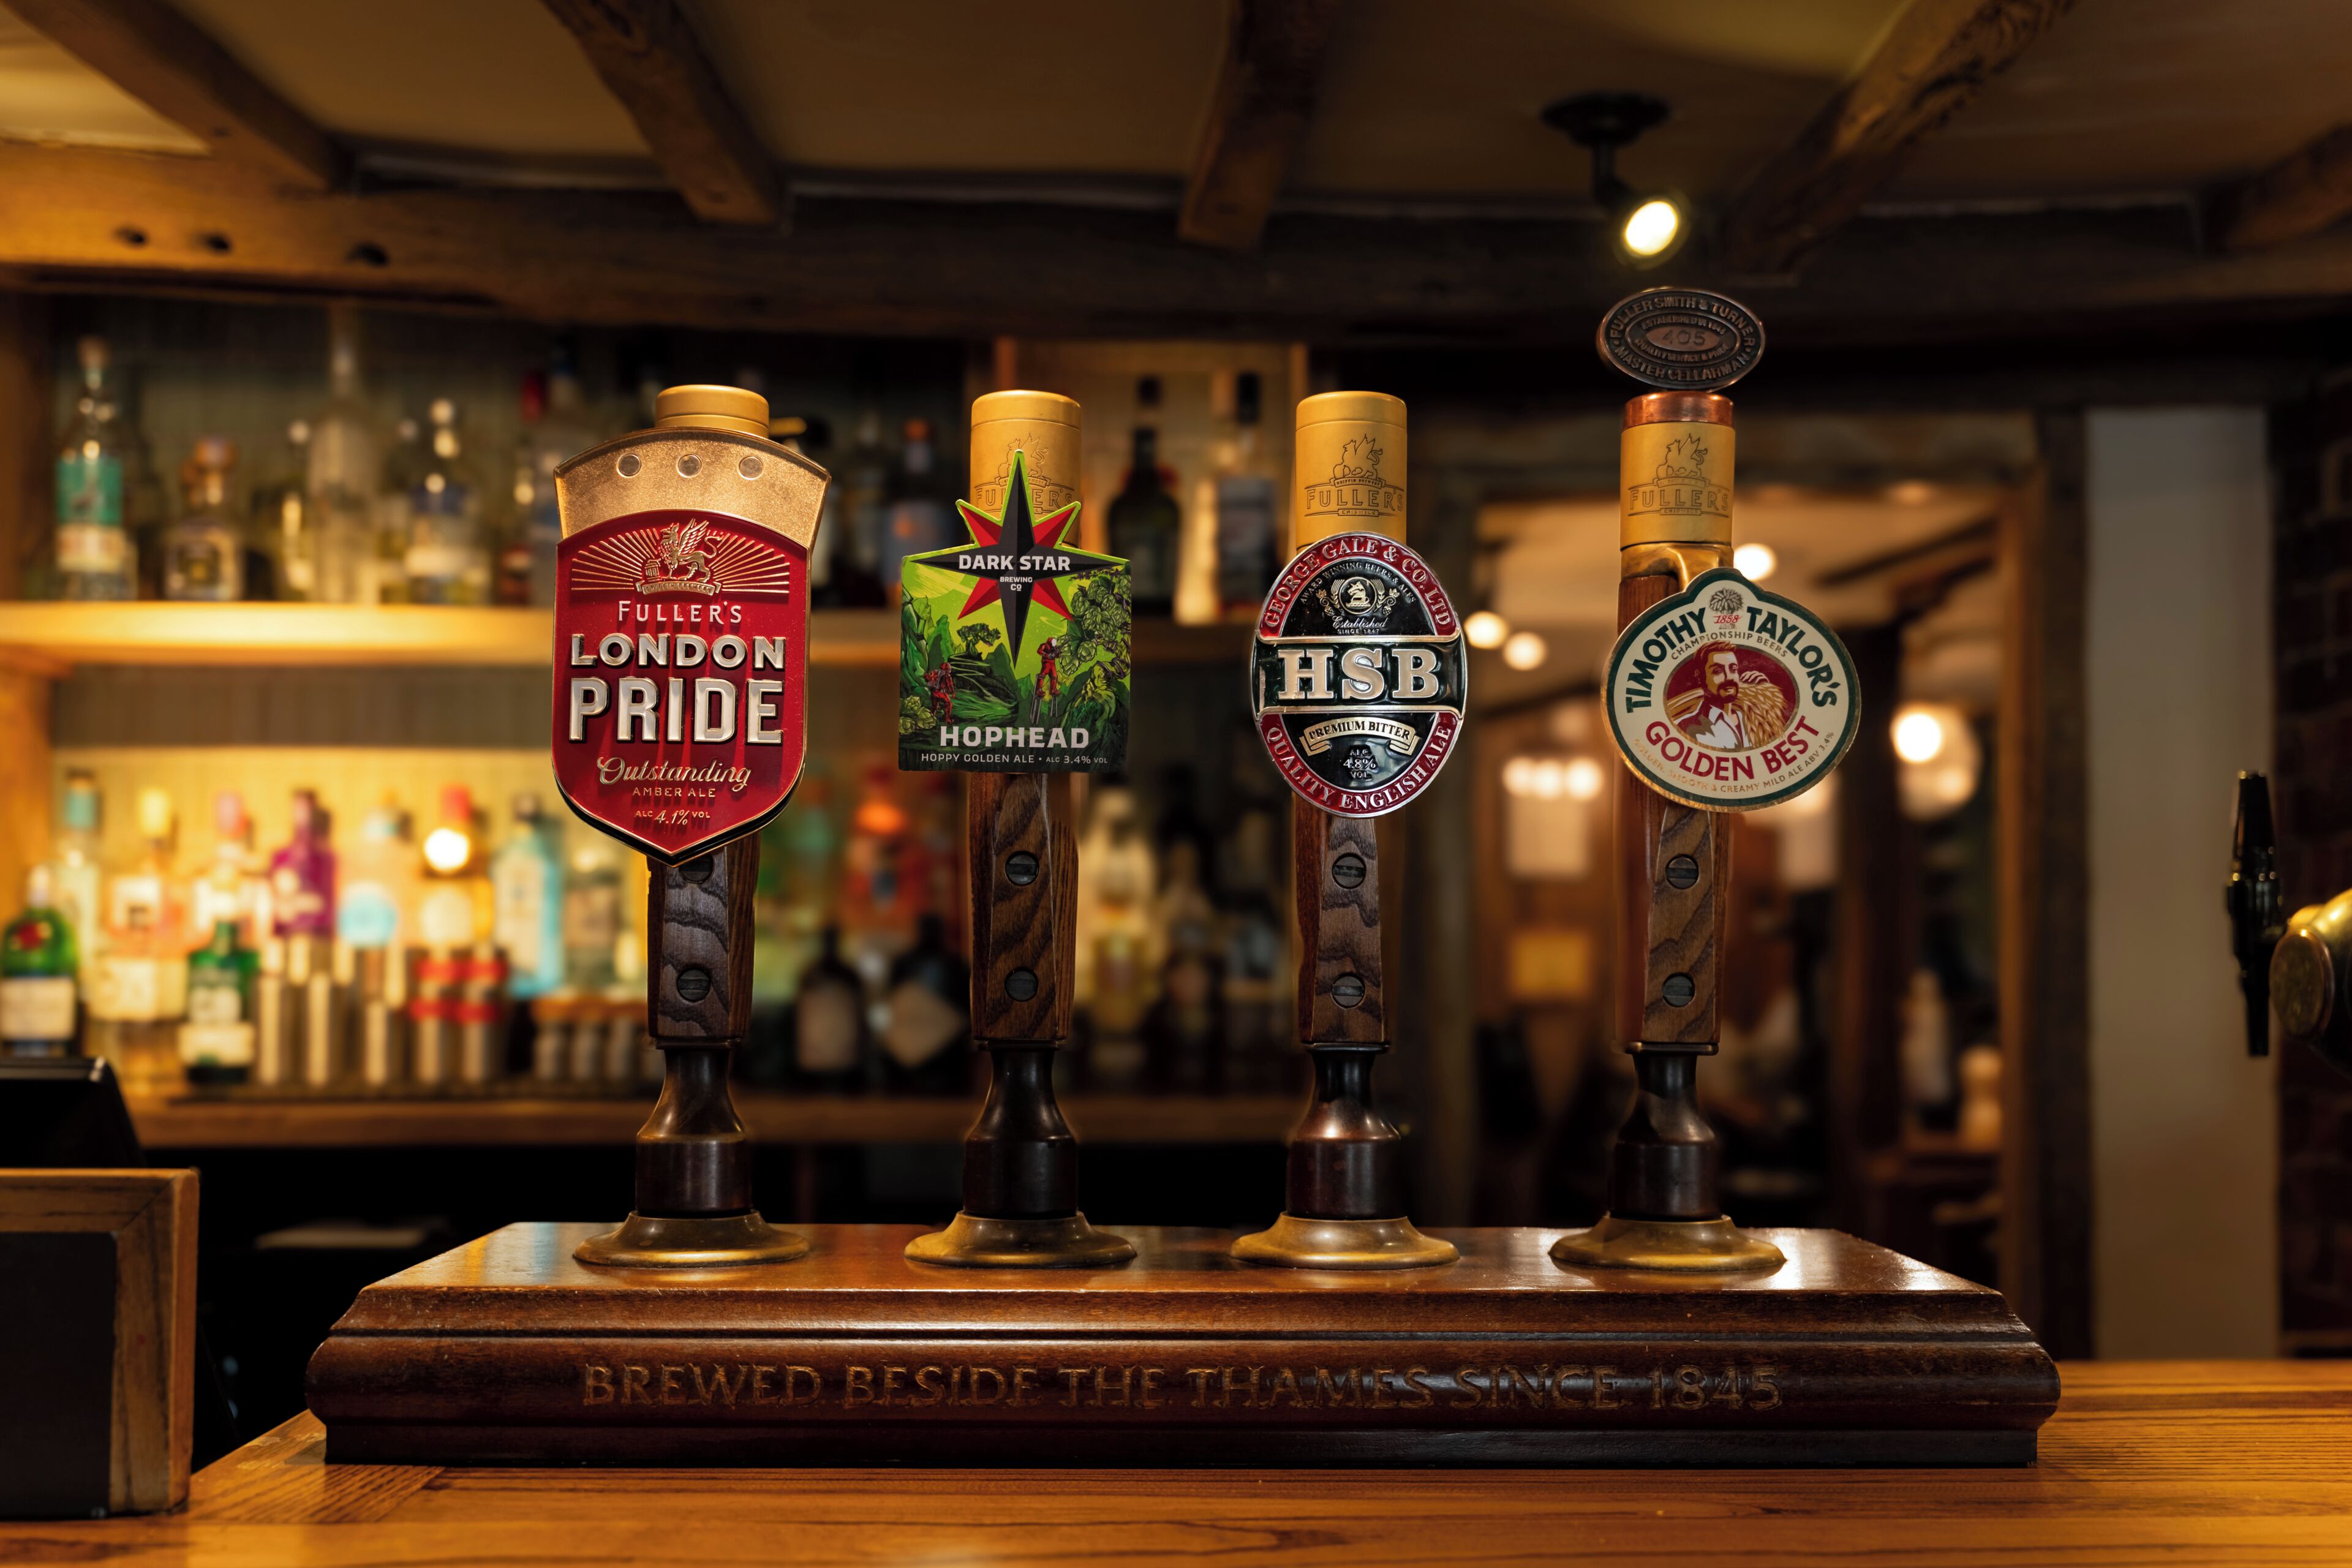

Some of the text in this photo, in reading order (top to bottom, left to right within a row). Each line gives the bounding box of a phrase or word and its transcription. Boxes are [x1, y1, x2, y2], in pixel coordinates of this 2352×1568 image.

[1610, 296, 1755, 348] FULLER SMITH & TURNER
[1615, 345, 1751, 381] MASTER CELLARMAN
[976, 488, 1072, 509] FUER'S
[1307, 489, 1403, 511] FULLER'S
[1630, 489, 1729, 511] FULLER'S
[959, 555, 1071, 571] DARK STAR
[1265, 554, 1320, 627] GEORGE
[1322, 538, 1378, 559] GALE
[1383, 546, 1399, 562] &
[1424, 587, 1451, 625] LTD
[1300, 578, 1322, 604] AWARD
[1322, 562, 1362, 579] WINNING
[1365, 564, 1392, 579] BEERS
[1399, 584, 1416, 603] ALES
[619, 600, 742, 625] FULLER'S
[1332, 616, 1389, 629] Established
[1713, 614, 1742, 624] 1858
[570, 633, 786, 671] LONDON
[1626, 606, 1841, 713] TIMOTHY TAYLOR'S
[1671, 631, 1788, 660] CHAMPIONSHIP BEERS
[1278, 647, 1439, 700] HSB
[568, 677, 784, 745] PRIDE
[940, 725, 1089, 748] HOPHEAD
[1308, 721, 1410, 740] PREMIUM BITTER
[921, 753, 960, 762] HOPPY
[964, 754, 1009, 763] GOLDEN
[1014, 755, 1035, 763] ALE
[1064, 755, 1091, 764] 3.4%
[1646, 715, 1819, 782] GOLDEN BEST
[1668, 769, 1708, 790] SMOOTH
[1721, 782, 1759, 793] CREAMY
[1763, 775, 1785, 788] MILD
[1789, 766, 1804, 779] ALE
[1805, 750, 1820, 767] ABV
[1819, 731, 1834, 752] 3.4%
[597, 757, 752, 792] Outstanding
[1267, 726, 1451, 809] QUALITY ENGLISH ALE
[1343, 759, 1376, 769] 4.8%
[632, 788, 716, 797] AMBER ALE
[654, 809, 690, 825] 4.1%
[583, 1363, 1782, 1409] BREWED BESIDE THE THAMES SINCE 1845
